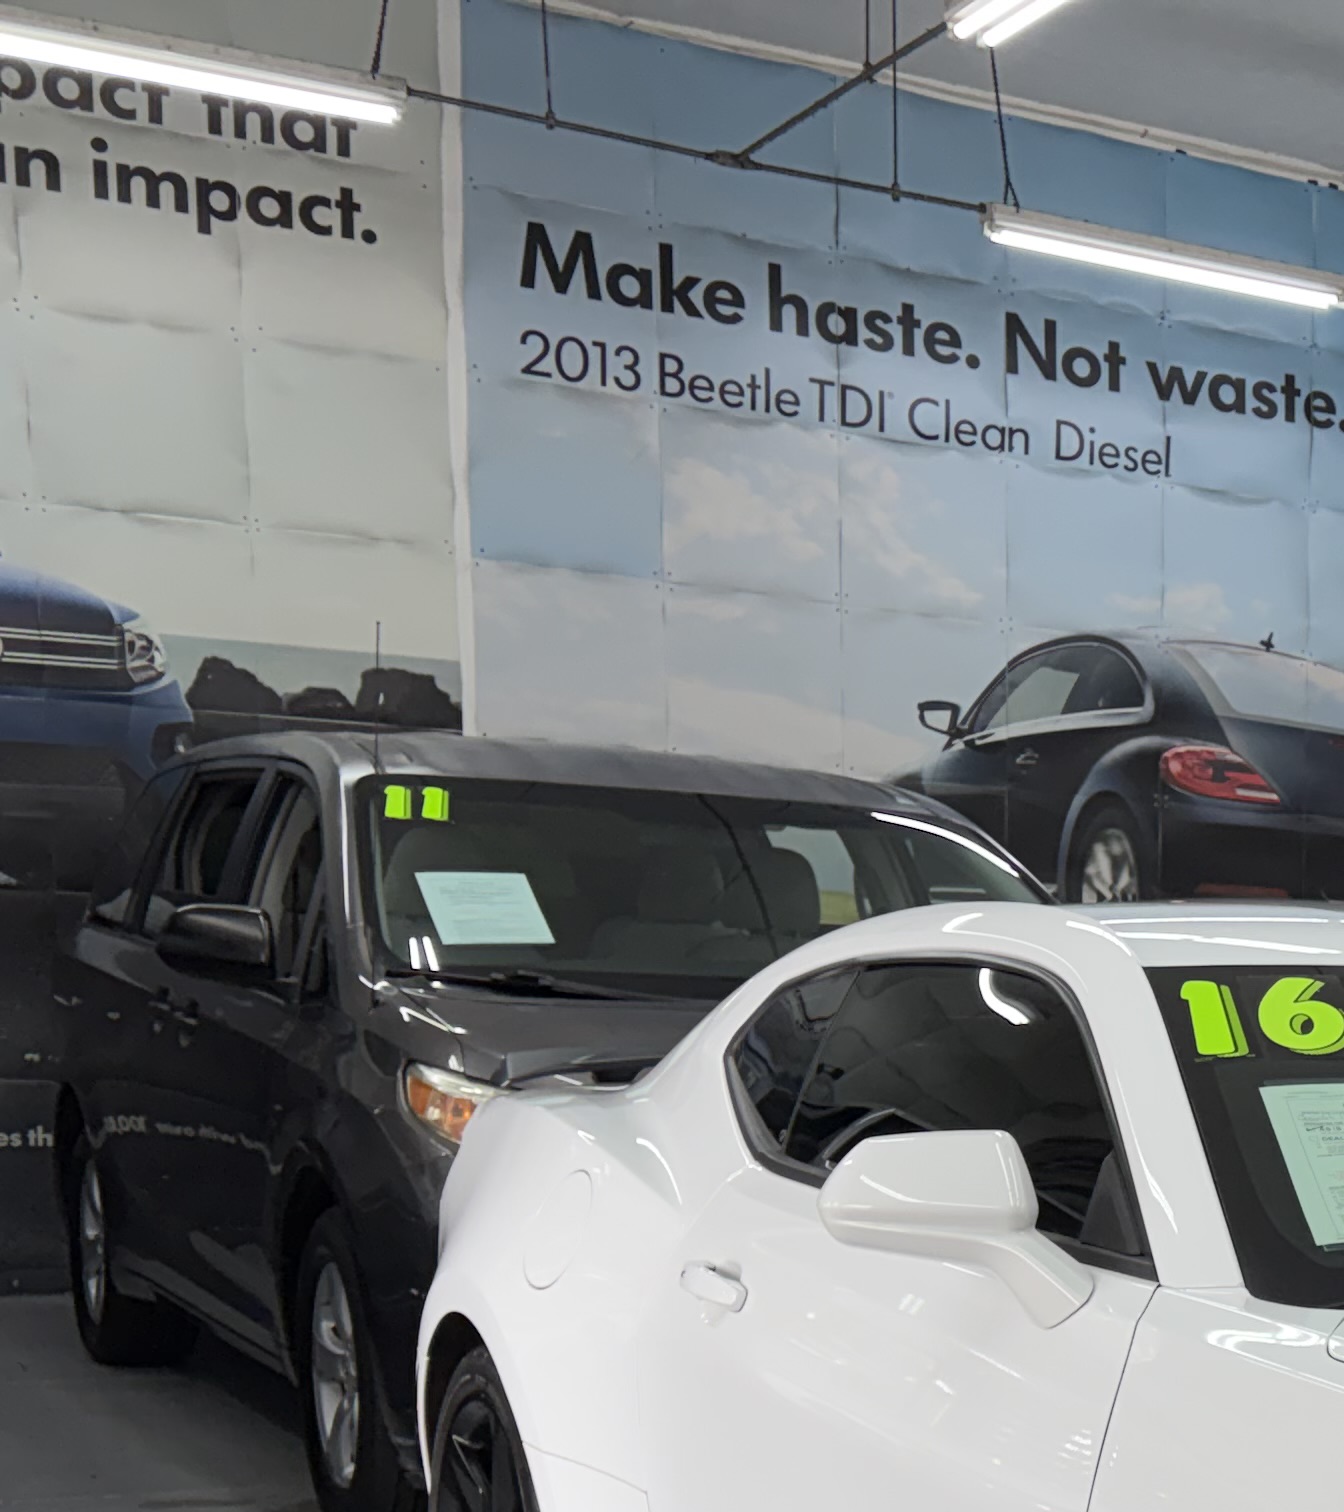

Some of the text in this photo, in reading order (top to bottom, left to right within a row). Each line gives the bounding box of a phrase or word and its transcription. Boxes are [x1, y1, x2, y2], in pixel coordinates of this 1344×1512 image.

[90, 136, 378, 245] impact.
[201, 94, 357, 159] that
[520, 221, 746, 325] Make
[768, 262, 981, 370] haste.
[1005, 311, 1127, 393] Not
[520, 329, 641, 392] 2013
[658, 351, 801, 418] Beetle
[908, 397, 1031, 456] Clean
[1055, 419, 1173, 478] Diesel
